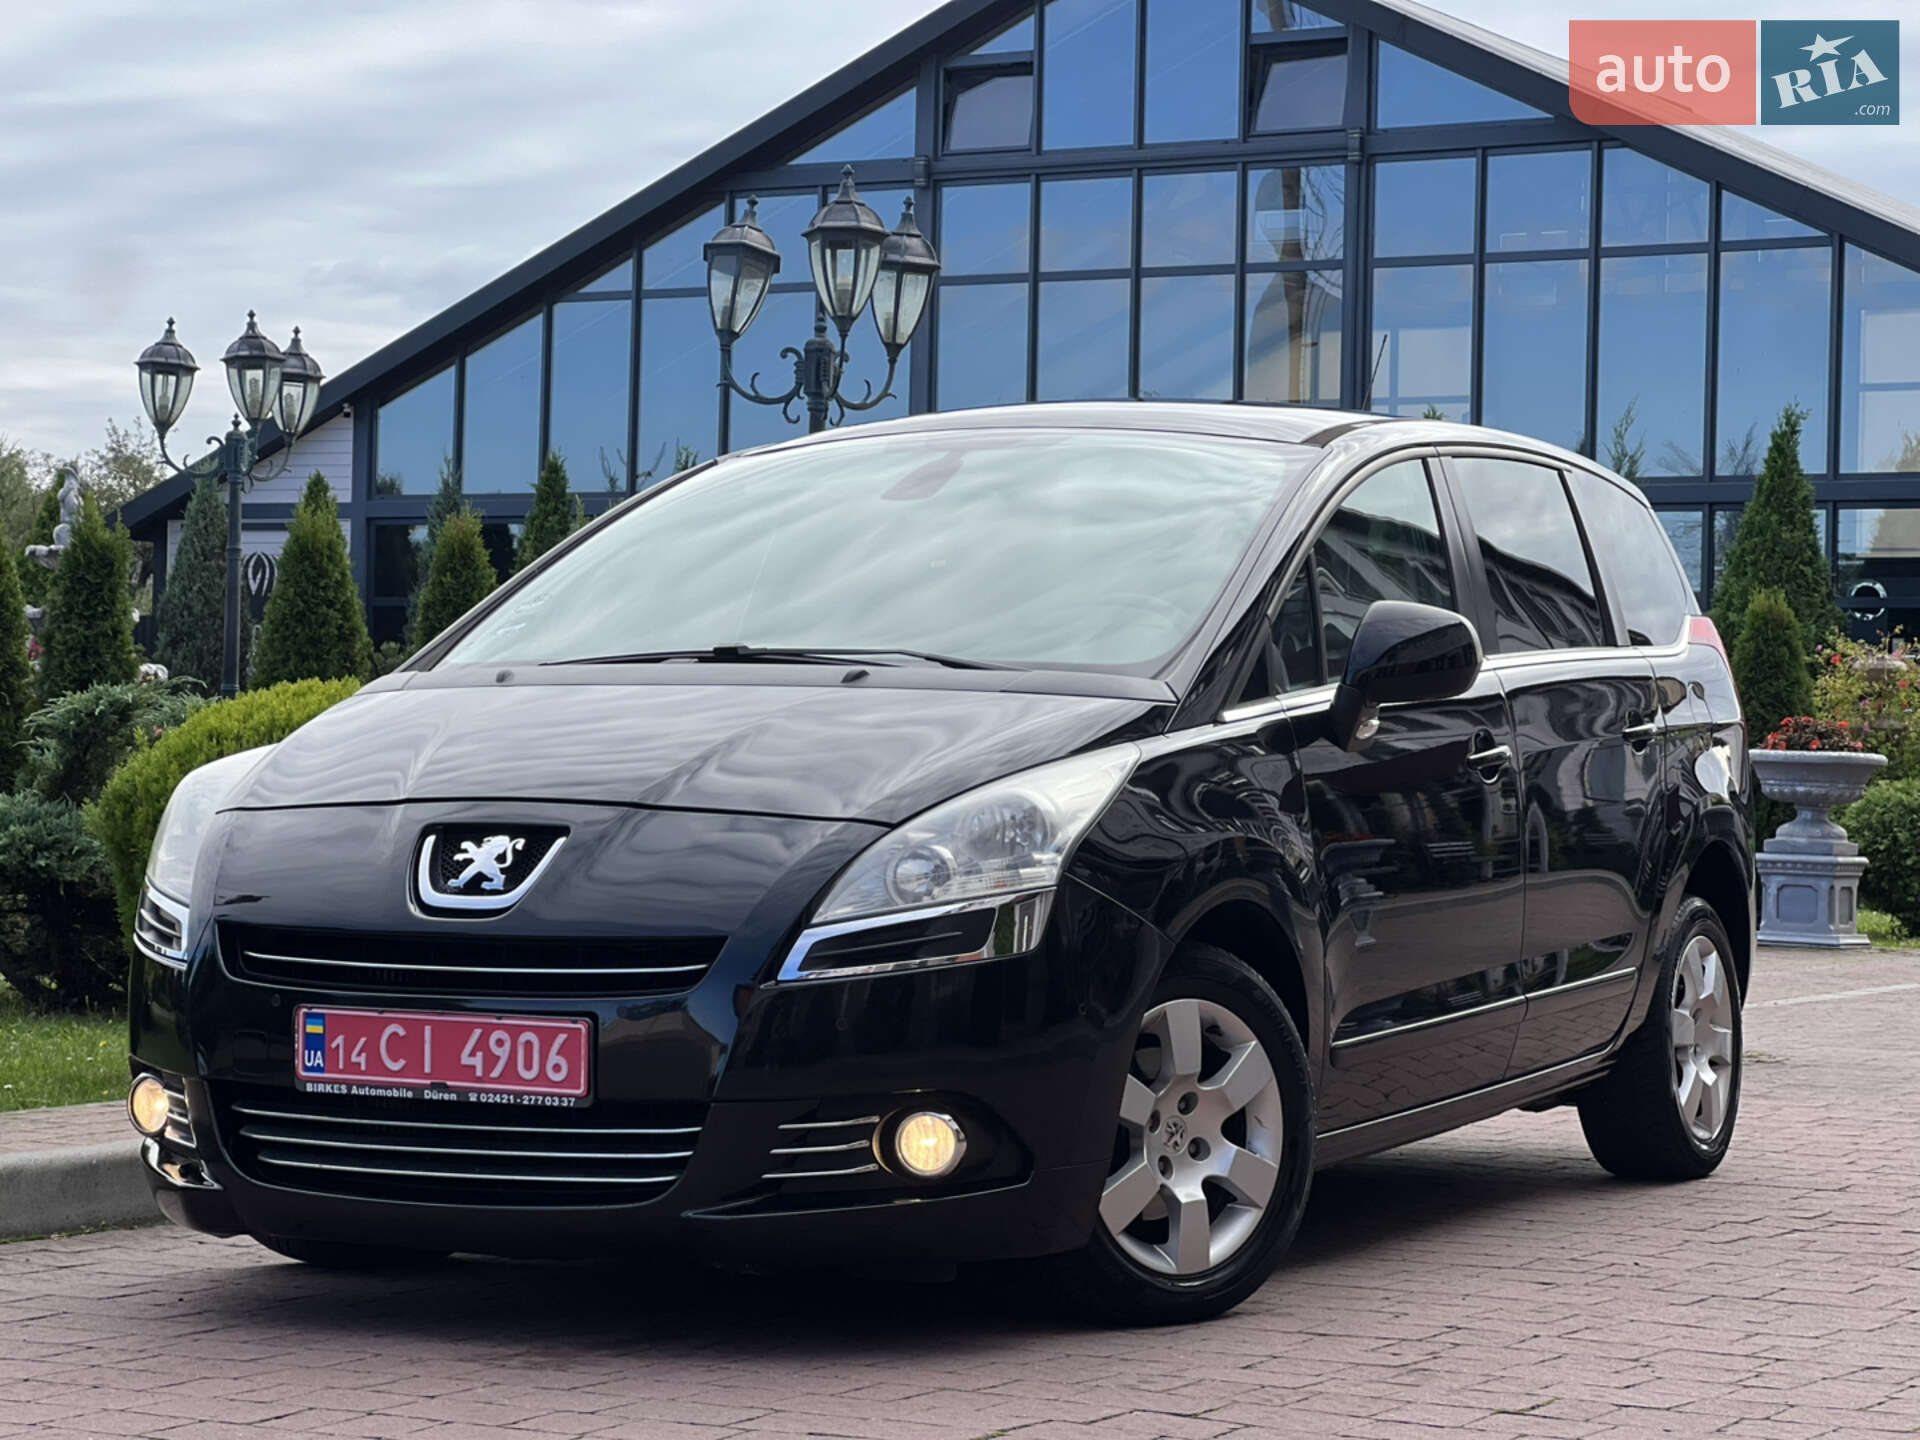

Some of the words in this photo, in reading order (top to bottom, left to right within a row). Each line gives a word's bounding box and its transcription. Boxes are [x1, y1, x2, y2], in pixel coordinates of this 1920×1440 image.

[304, 1049, 324, 1067] UA
[330, 1034, 367, 1071] 14
[460, 1028, 569, 1082] 4906
[305, 1082, 348, 1094] BIRKES
[351, 1085, 414, 1098] Automobile
[423, 1089, 457, 1101] Düren
